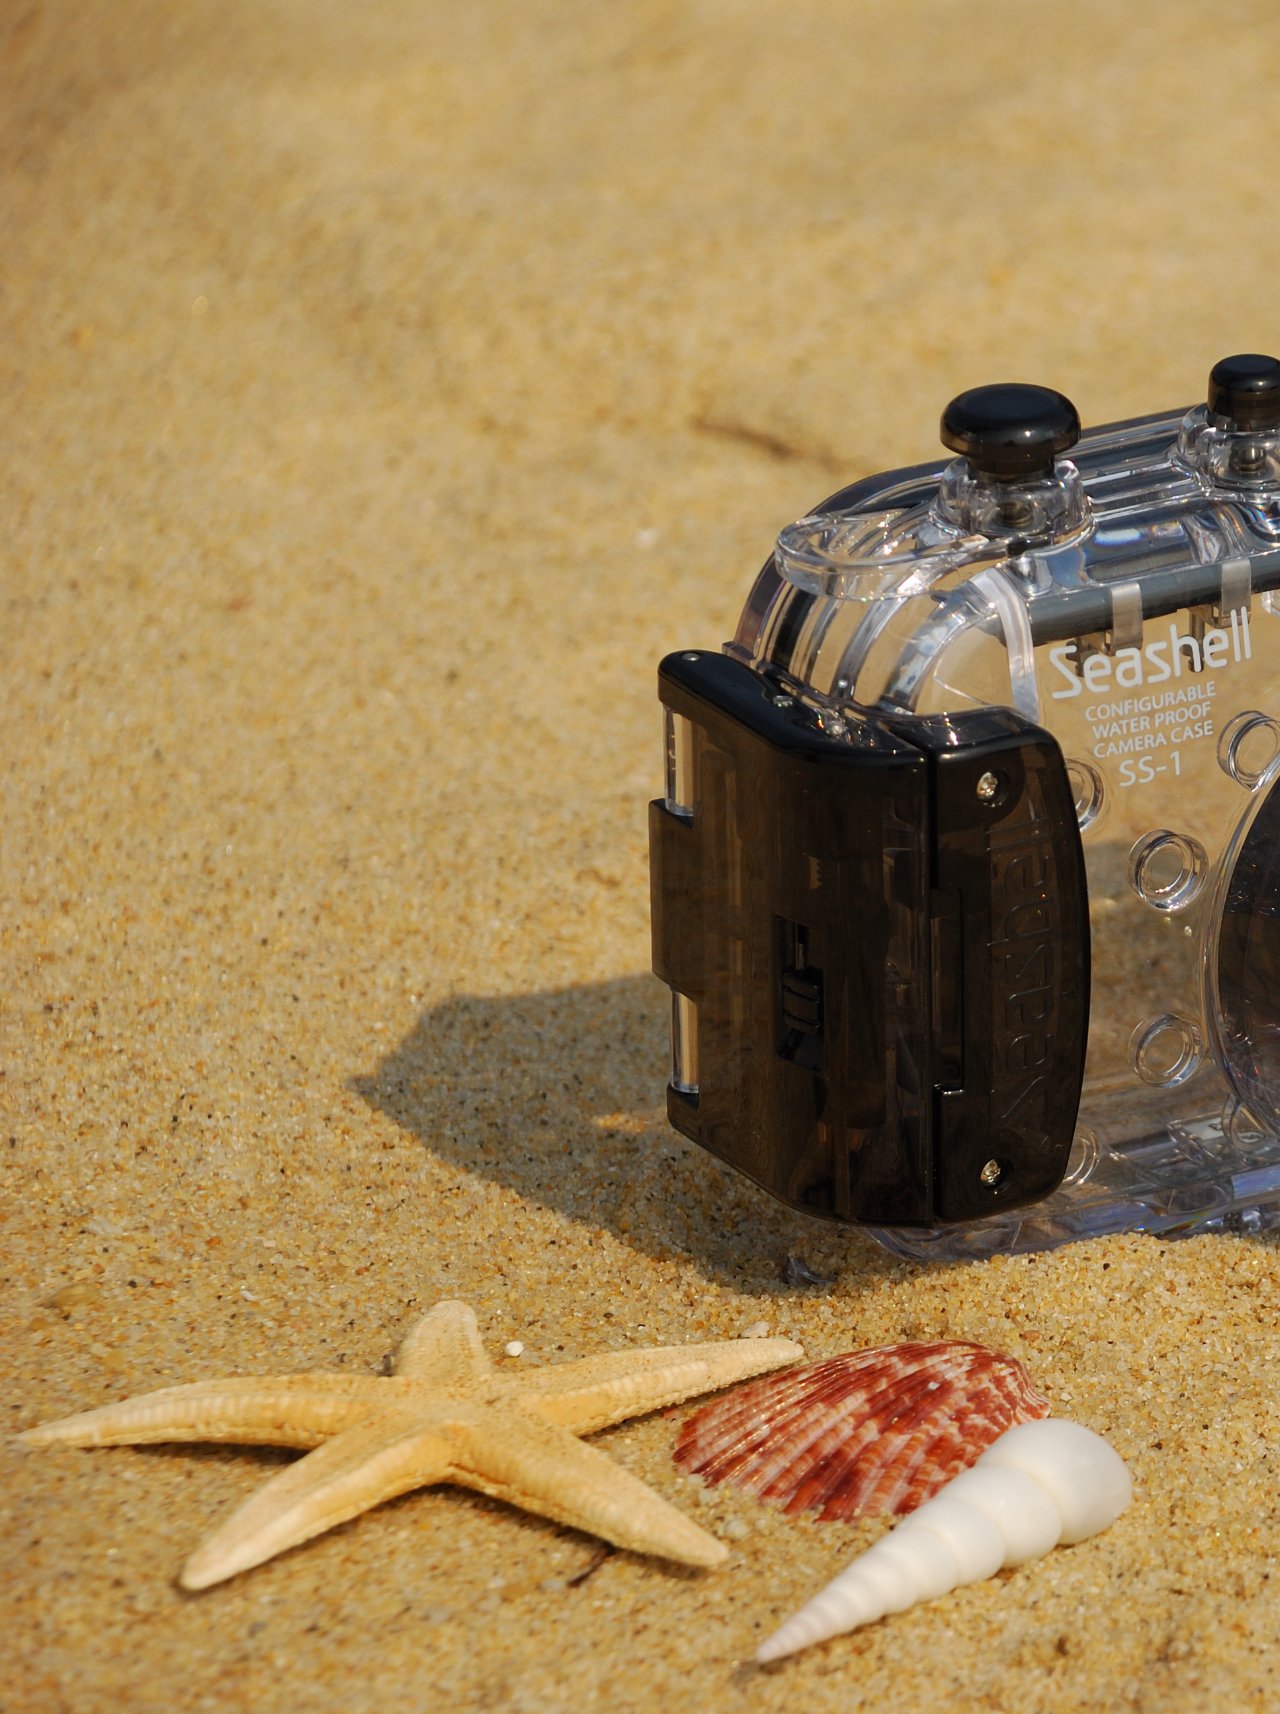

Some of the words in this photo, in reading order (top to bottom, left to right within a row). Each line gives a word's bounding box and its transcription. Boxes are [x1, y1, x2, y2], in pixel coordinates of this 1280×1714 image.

[1048, 605, 1252, 700] Seashell
[1085, 681, 1216, 722] CONFIGURABLE
[1092, 717, 1150, 739] WATER
[1154, 701, 1212, 728] PROOF
[1093, 731, 1167, 758] CAMERA
[1170, 720, 1214, 745] CASE
[1118, 750, 1182, 788] SS-1
